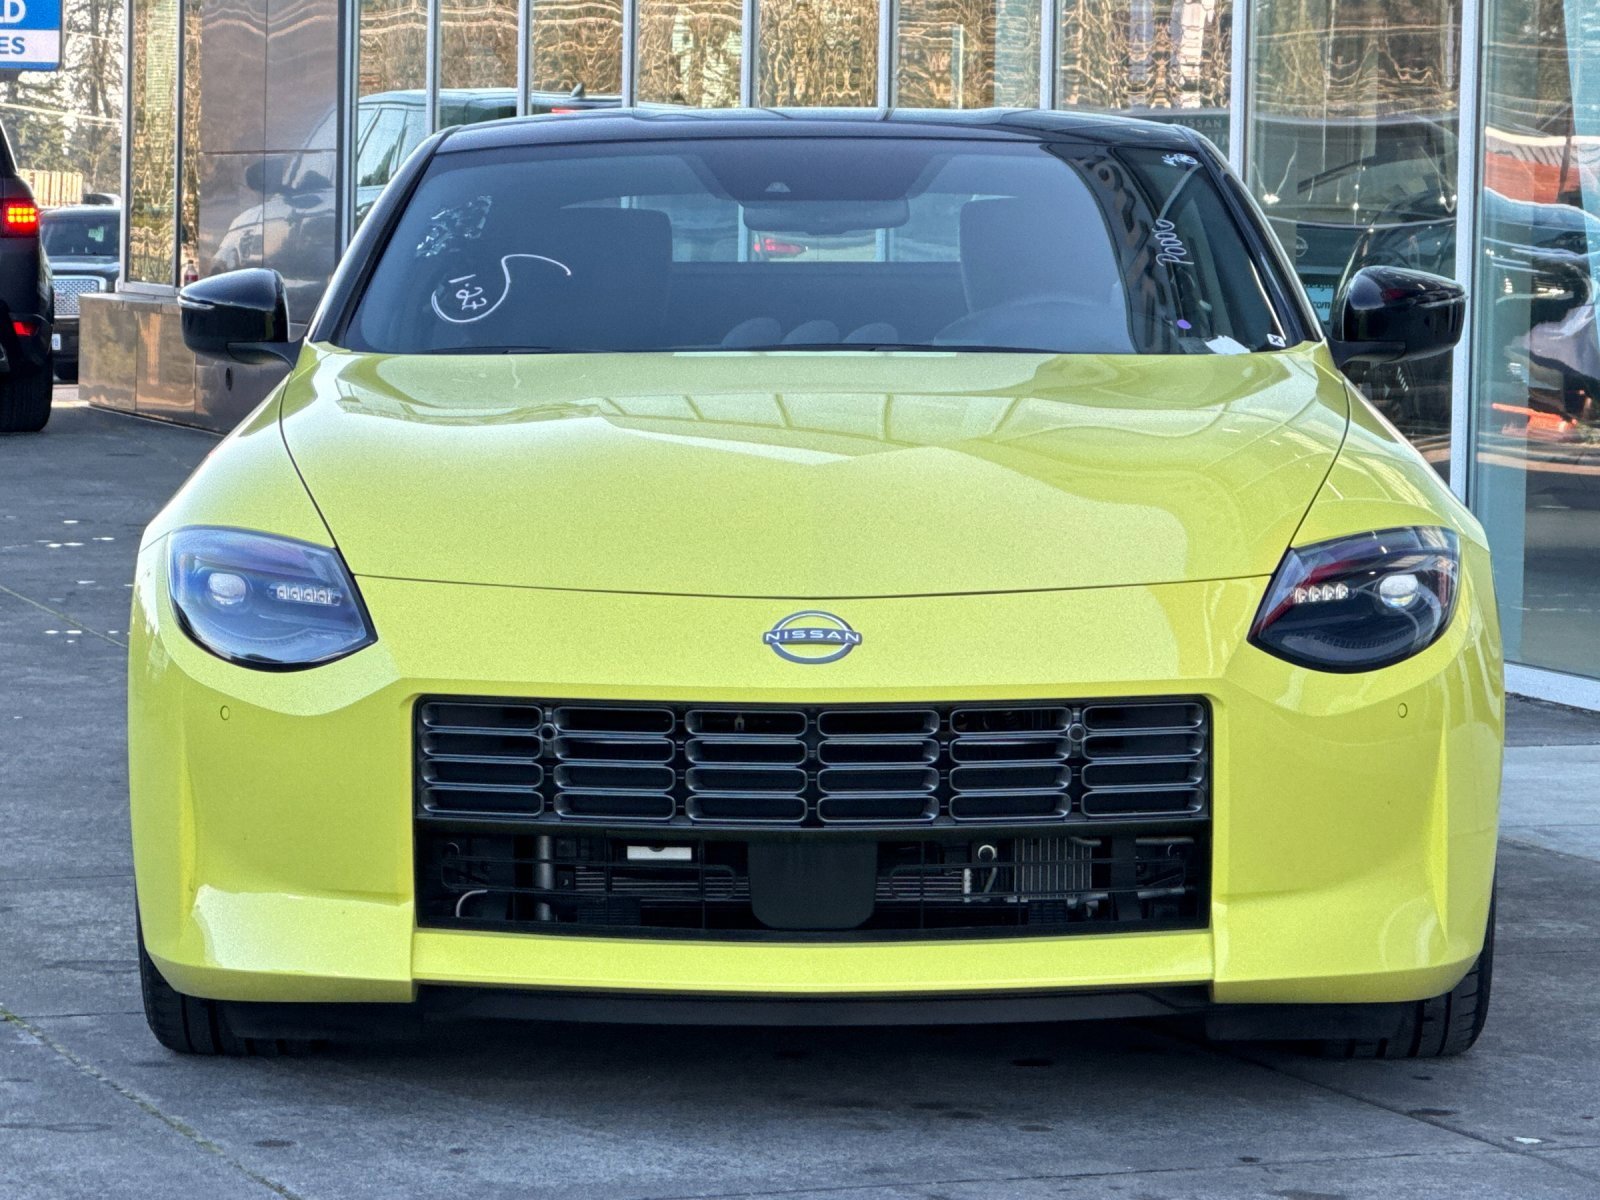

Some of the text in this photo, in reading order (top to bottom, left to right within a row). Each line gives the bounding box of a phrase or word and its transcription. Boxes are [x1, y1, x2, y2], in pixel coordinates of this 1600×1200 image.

[0, 0, 26, 23] D
[0, 36, 26, 55] ES
[1172, 118, 1223, 129] NISSAN
[765, 630, 860, 642] NISSAN
